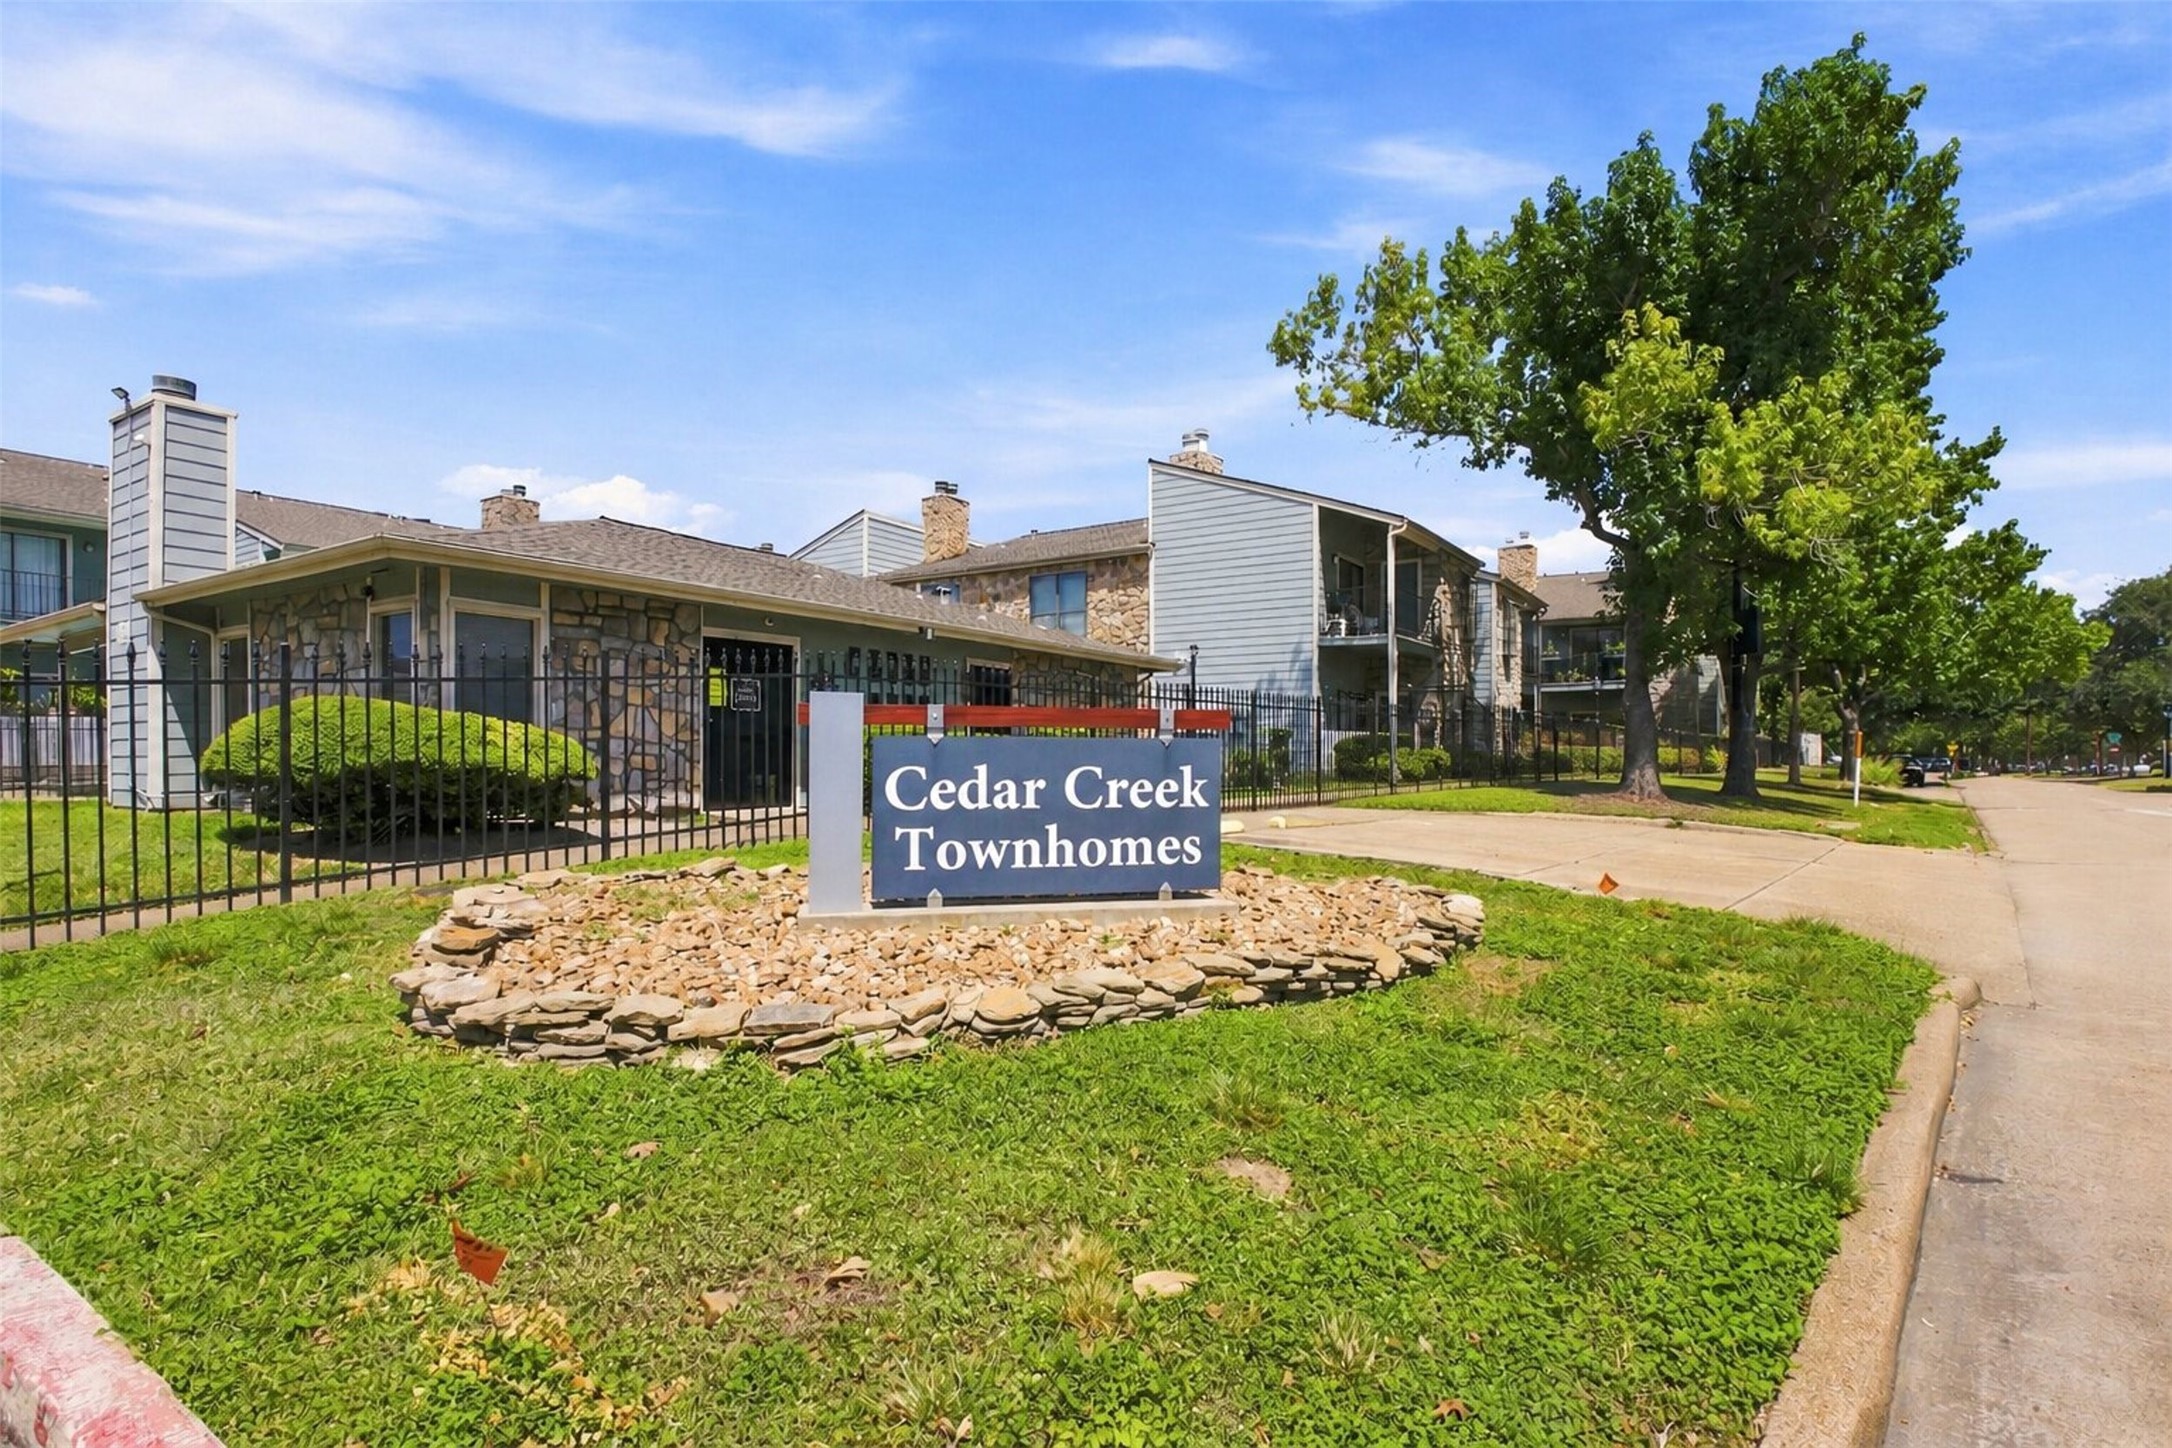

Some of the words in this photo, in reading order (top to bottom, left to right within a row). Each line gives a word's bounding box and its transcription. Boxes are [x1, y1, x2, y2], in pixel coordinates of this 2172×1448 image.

[884, 763, 1047, 811] Cedar
[1064, 764, 1210, 810] Creek
[894, 822, 1203, 872] Townhomes
